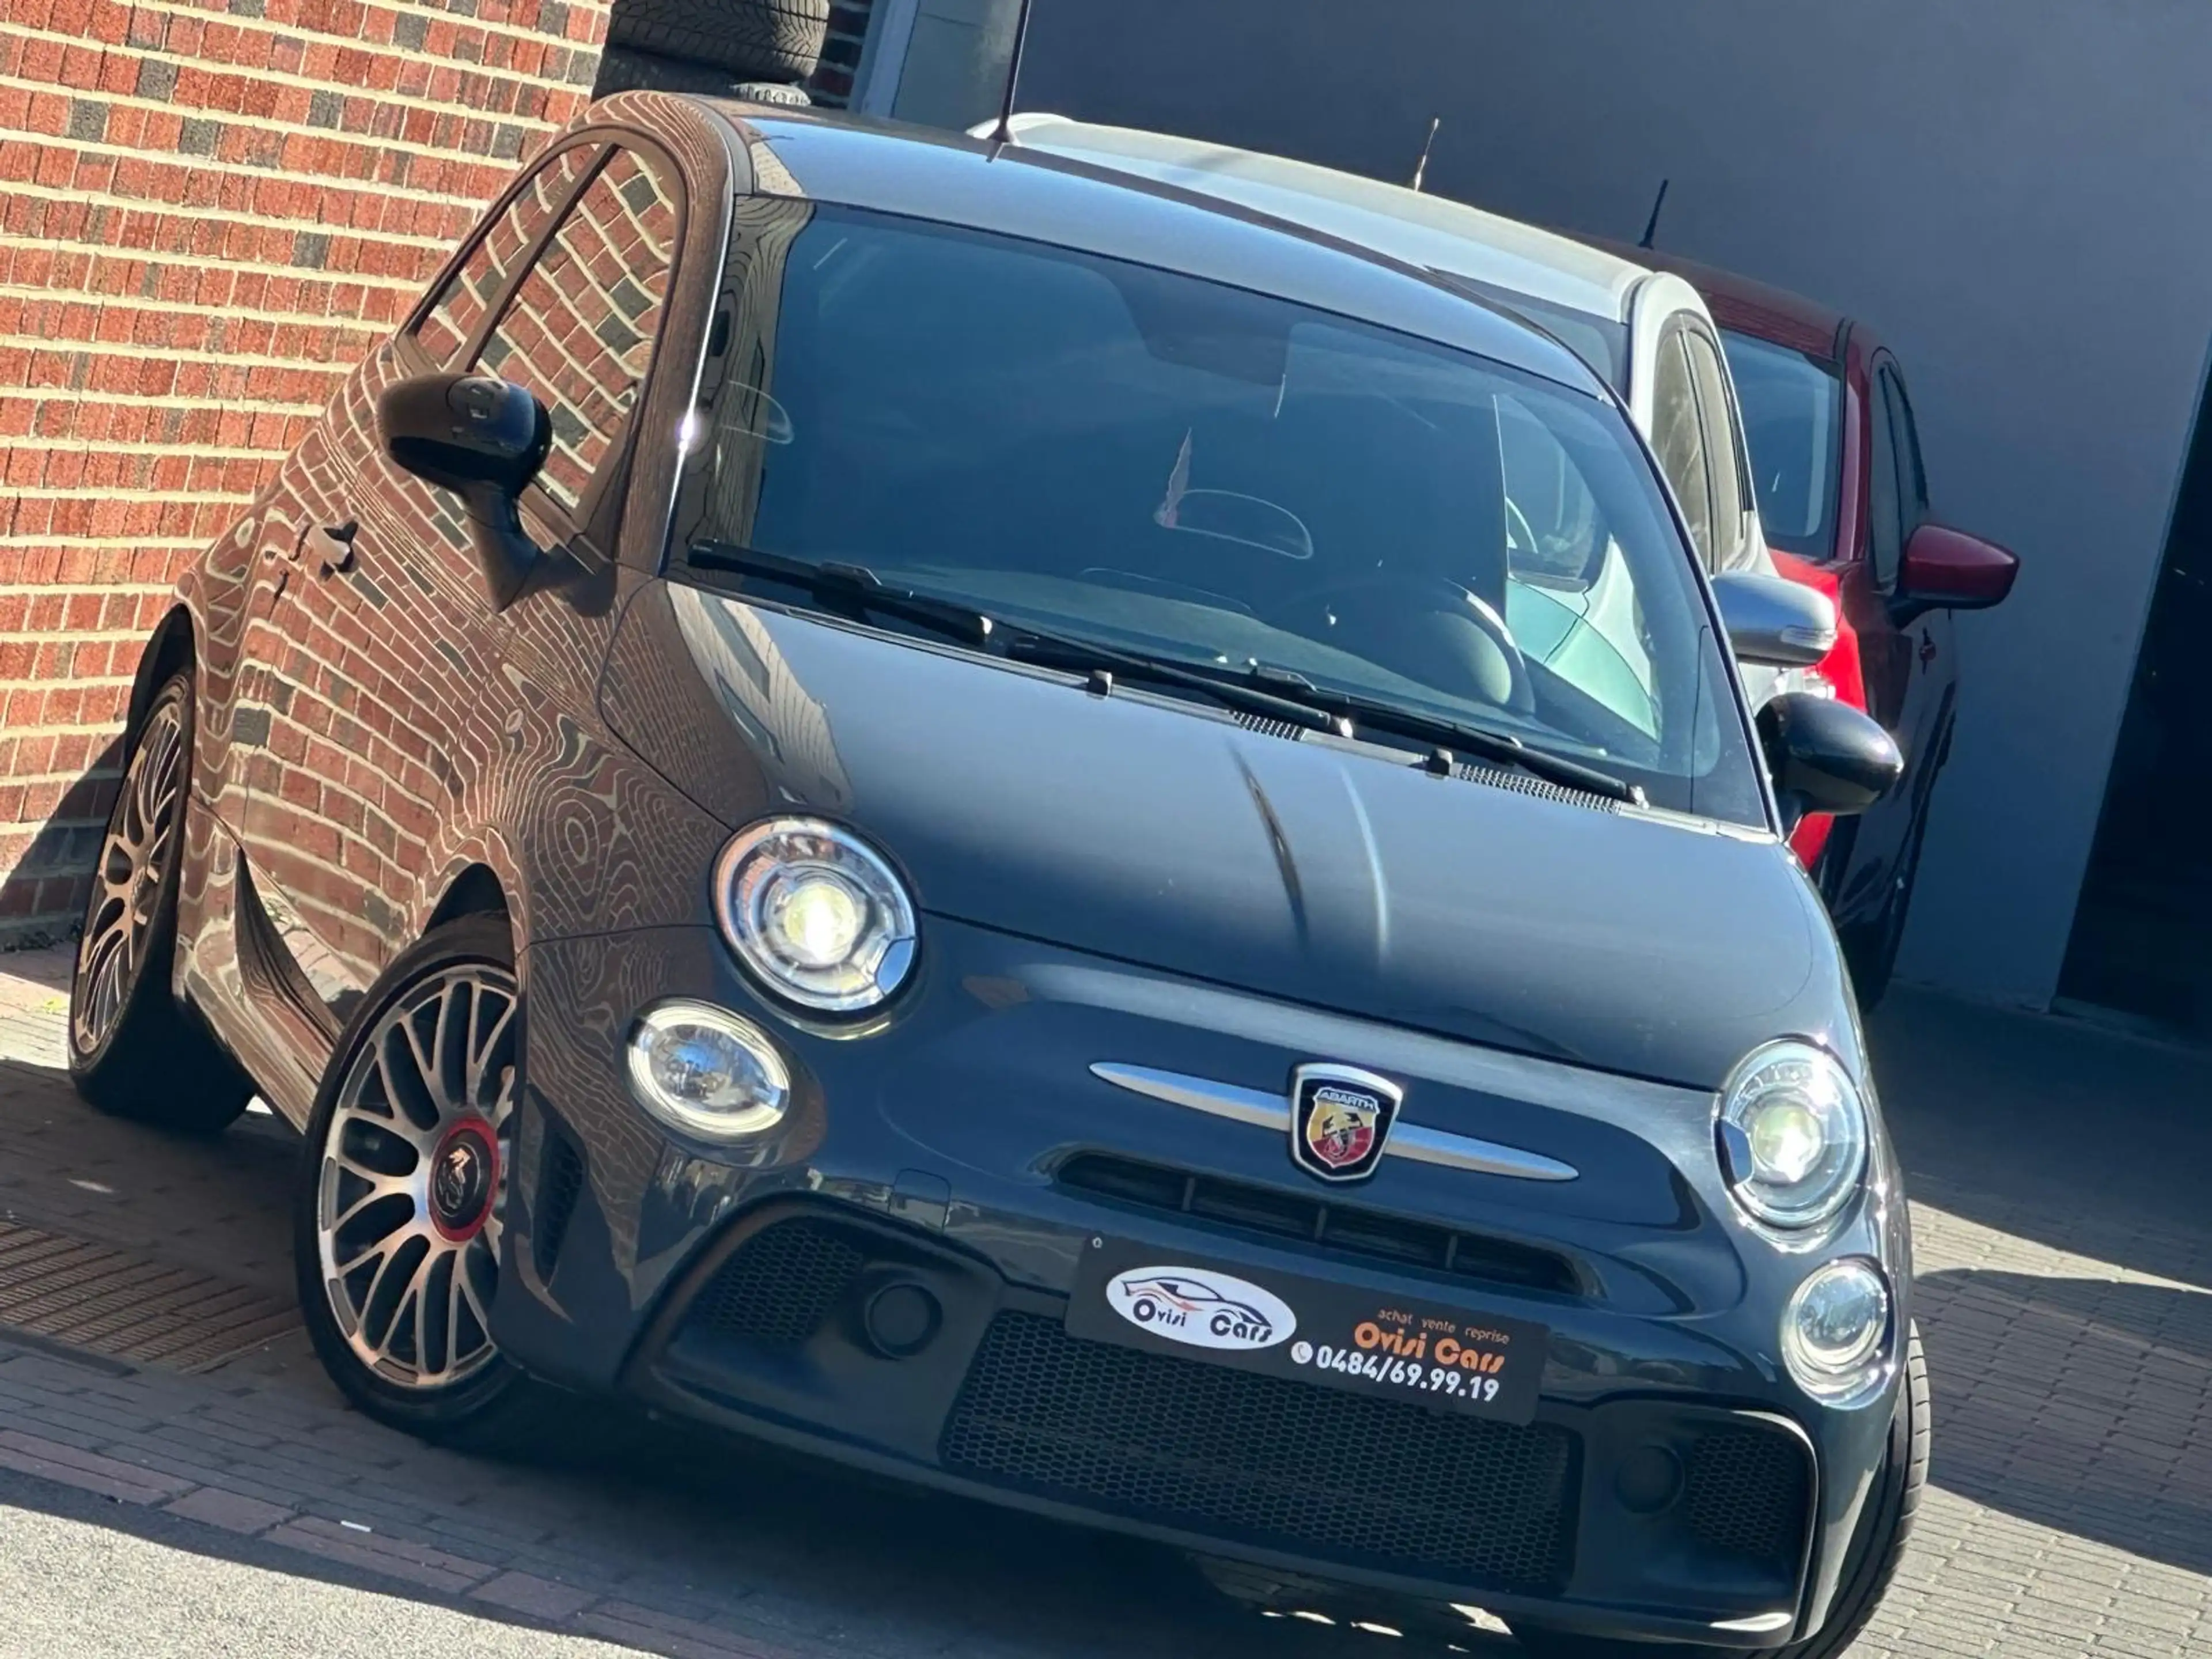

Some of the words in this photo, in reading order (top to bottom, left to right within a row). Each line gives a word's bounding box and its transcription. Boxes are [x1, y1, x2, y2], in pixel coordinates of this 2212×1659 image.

[1320, 1091, 1374, 1111] ABARTH
[1210, 1314, 1273, 1343] Cars
[1377, 1309, 1414, 1325] achat
[1421, 1317, 1456, 1334] vente
[1465, 1326, 1510, 1346] reprise
[1354, 1321, 1427, 1359] Ovisi
[1435, 1338, 1505, 1374] Cars
[1316, 1345, 1500, 1402] 0484/69.99.19
